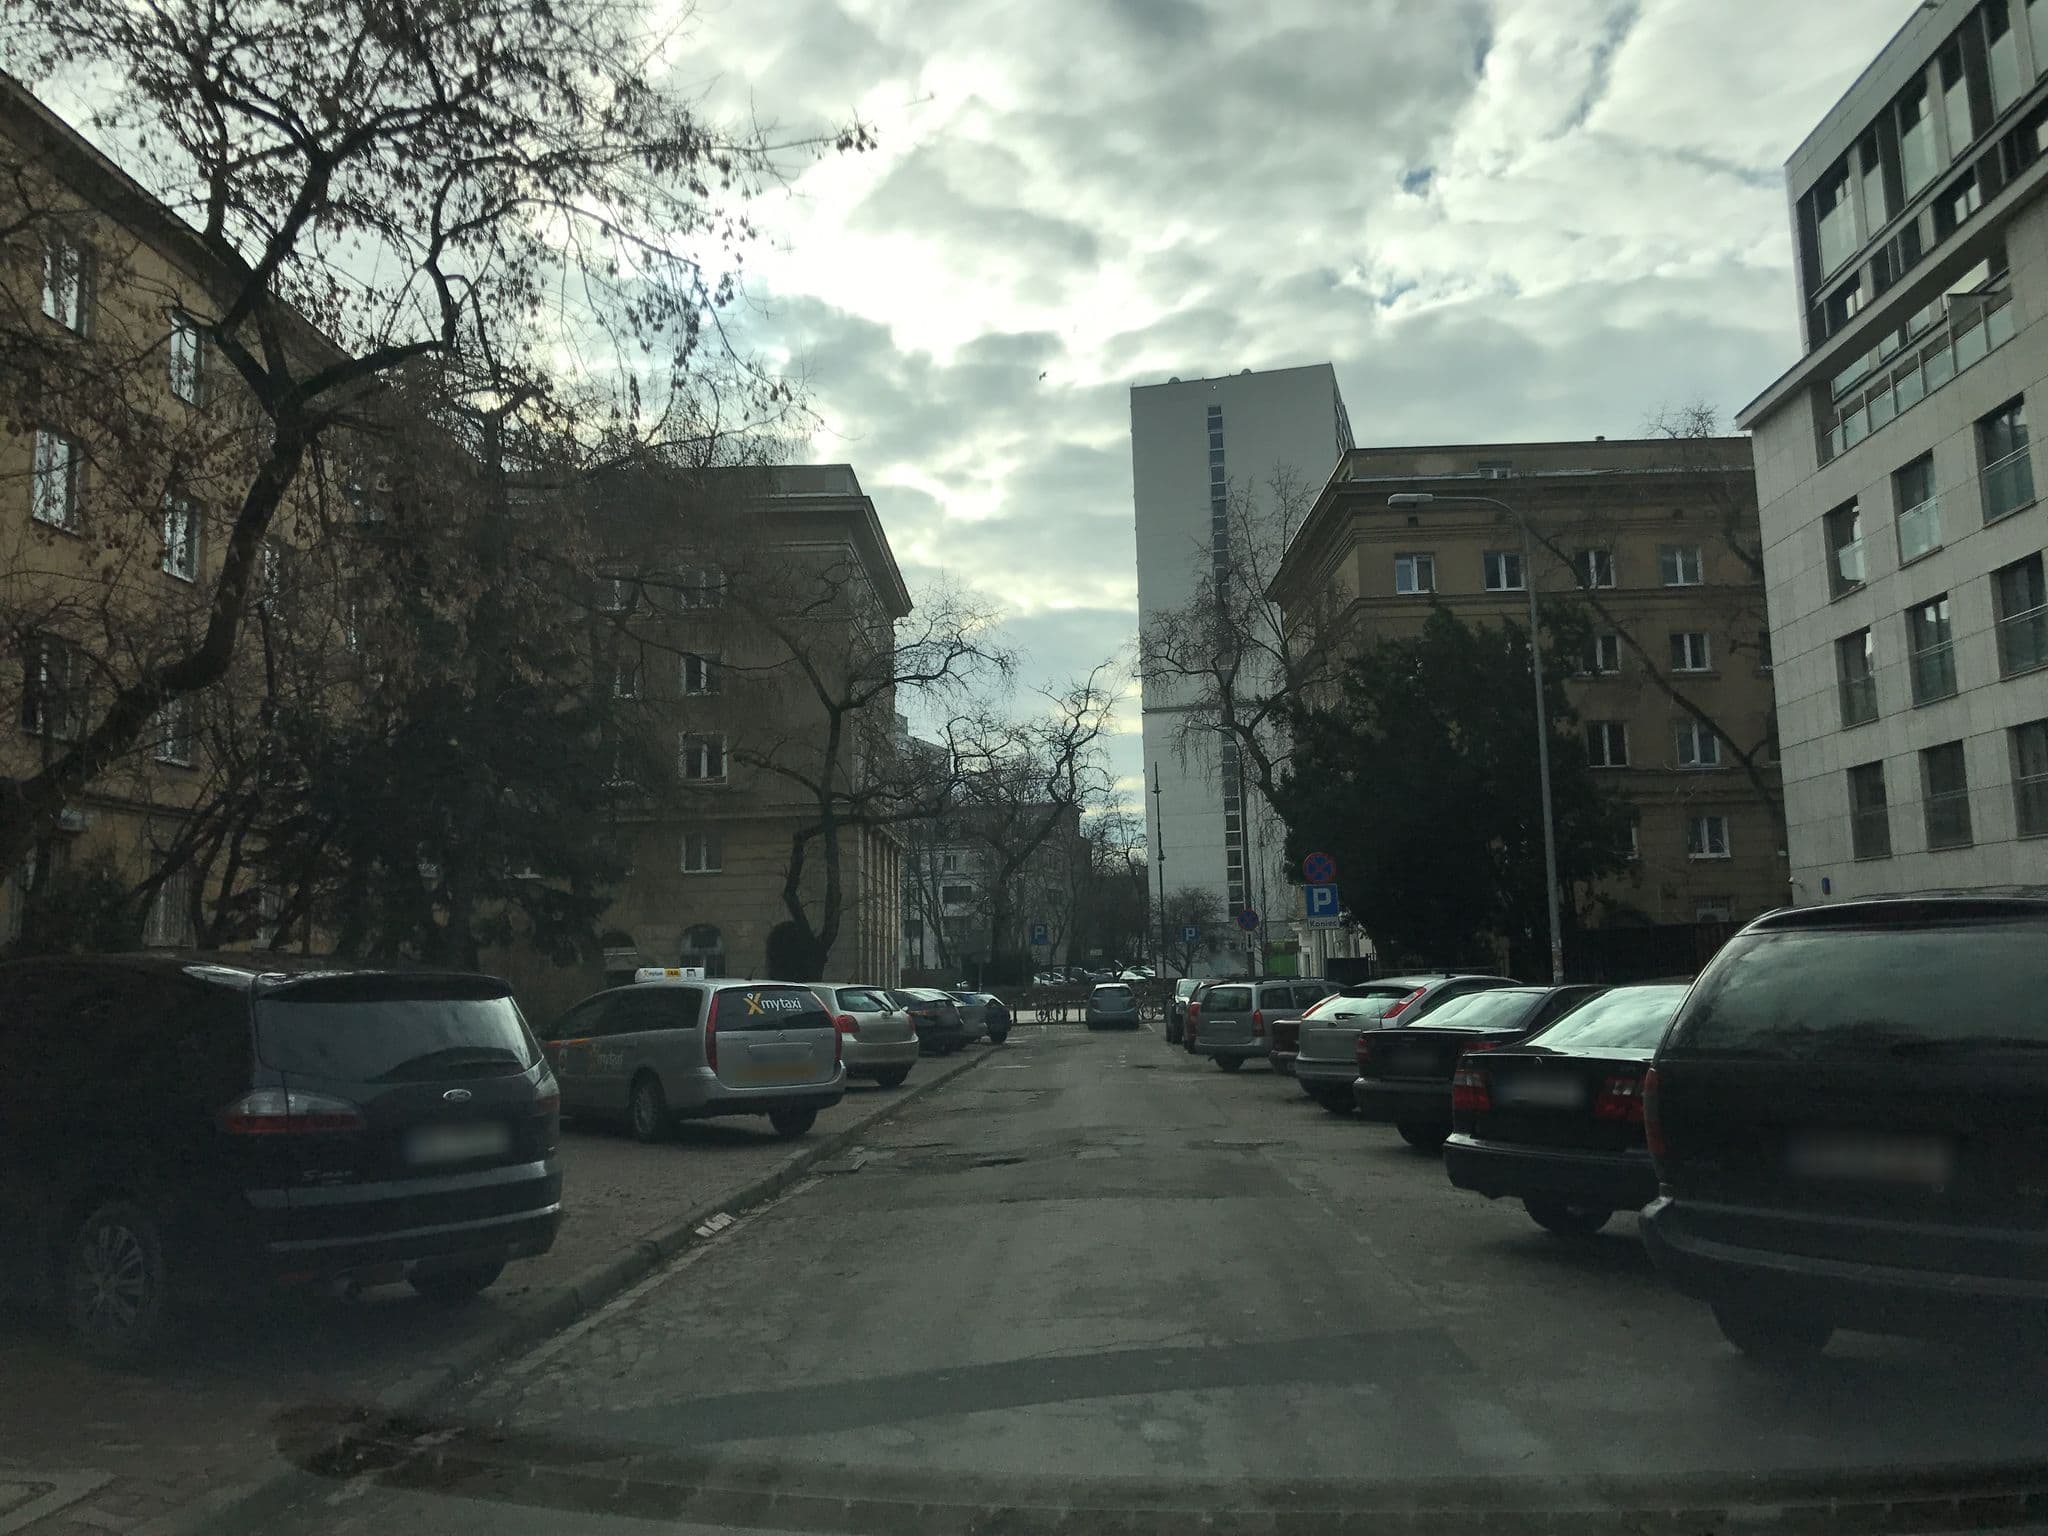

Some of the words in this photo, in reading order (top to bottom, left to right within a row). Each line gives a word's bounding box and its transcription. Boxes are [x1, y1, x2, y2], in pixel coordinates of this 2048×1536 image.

[1312, 887, 1332, 913] P
[1310, 919, 1337, 927] Koniec
[1034, 924, 1046, 939] P
[1186, 927, 1196, 941] P
[760, 997, 802, 1012] mytaxi
